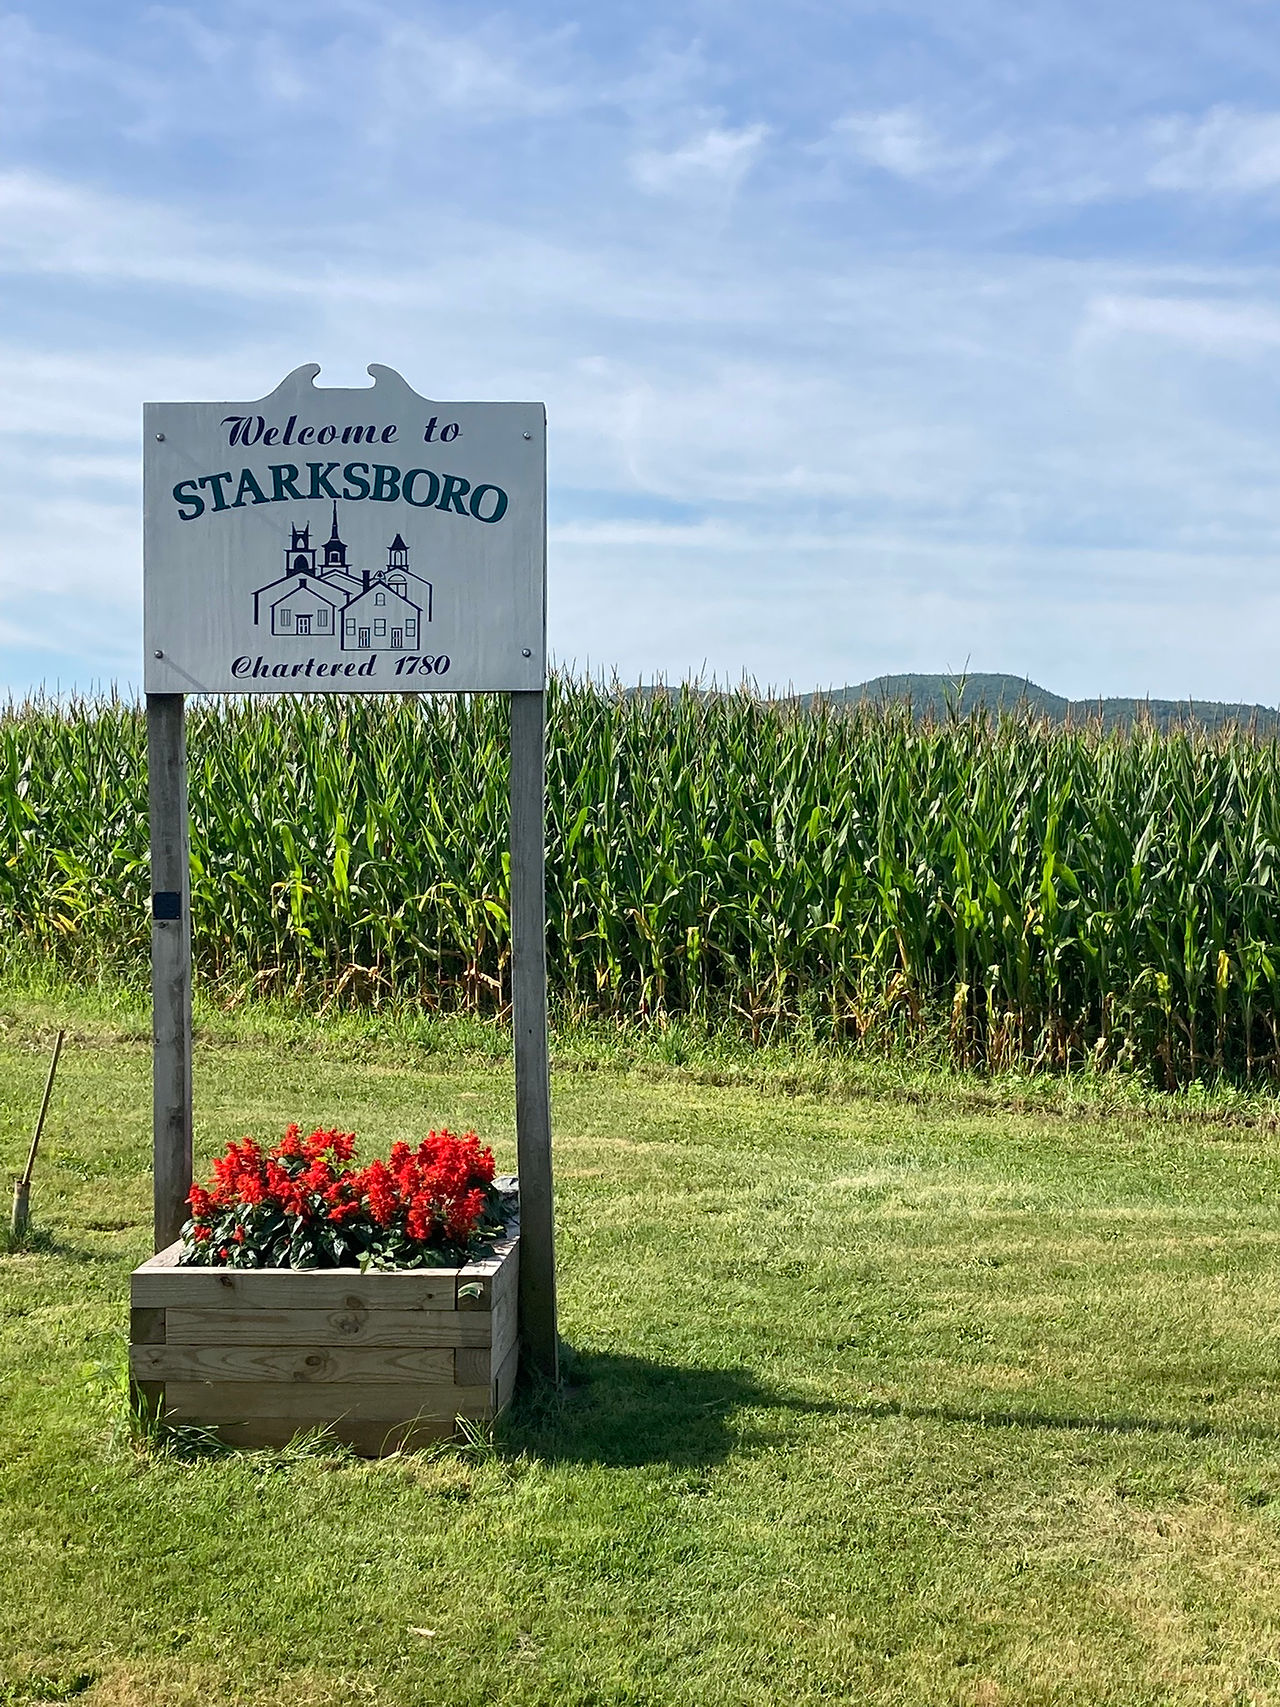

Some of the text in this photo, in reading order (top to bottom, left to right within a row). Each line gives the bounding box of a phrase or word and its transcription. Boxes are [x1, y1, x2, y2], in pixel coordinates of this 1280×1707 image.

[221, 415, 463, 447] Welcome to
[172, 462, 509, 523] STARKSBORO
[231, 654, 451, 679] Chartered 1780
